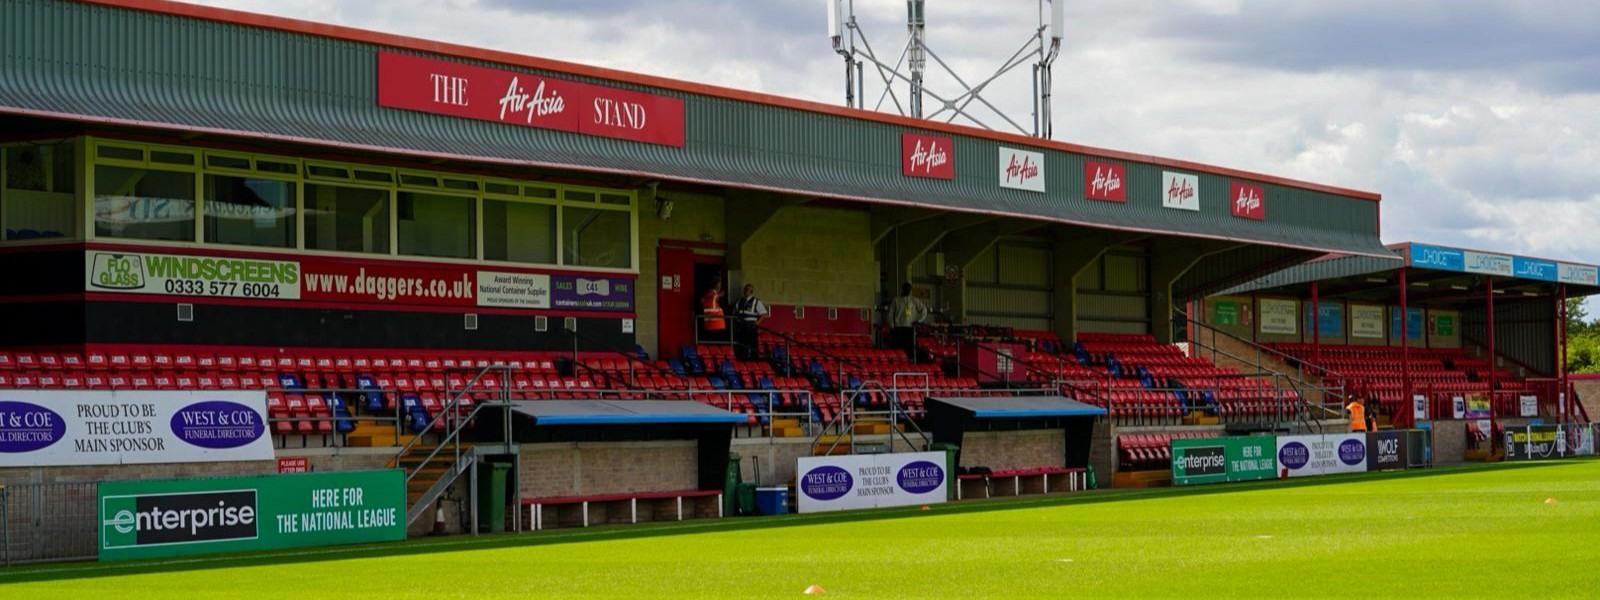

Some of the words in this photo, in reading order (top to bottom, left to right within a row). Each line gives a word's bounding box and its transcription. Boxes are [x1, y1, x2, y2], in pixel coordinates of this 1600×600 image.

[430, 73, 469, 106] THE
[499, 76, 565, 123] AirAsia
[593, 97, 646, 130] STAND
[910, 139, 947, 173] AirAsia
[1006, 153, 1038, 183] AirAsia
[1092, 167, 1121, 192] AirAsia
[108, 259, 130, 273] FLO
[145, 256, 298, 284] WINDSCREENS
[100, 271, 139, 286] GLASS
[305, 267, 473, 301] www.daggers.co.uk
[494, 274, 511, 284] Award
[512, 276, 533, 287] Winning
[165, 279, 205, 294] 0333
[209, 281, 238, 296] 577
[242, 283, 280, 297] 6004
[480, 285, 501, 293] National
[502, 286, 526, 295] Container
[77, 404, 120, 418] PROUD
[121, 404, 139, 418] TO
[142, 404, 157, 417] BE
[182, 410, 214, 426] WEST
[218, 410, 229, 425] &
[230, 410, 254, 425] COE
[9, 411, 22, 428] &
[24, 411, 53, 428] COE
[86, 421, 112, 435] THE
[112, 420, 153, 435] CLUB'S
[8, 431, 53, 442] DIRECTORS
[184, 429, 216, 439] FUNERAL
[217, 428, 256, 439] DIRECTORS
[74, 438, 109, 453] MAIN
[110, 437, 165, 451] SPONSOR
[1379, 438, 1398, 455] WOLF
[1177, 451, 1225, 472] enterprise
[807, 473, 825, 485] WEST
[826, 473, 834, 483] &
[834, 471, 848, 483] COE
[858, 467, 876, 476] PROUD
[902, 467, 919, 478] WEST
[920, 468, 926, 478] &
[926, 466, 938, 477] COE
[312, 488, 340, 508] HERE
[343, 487, 363, 506] FOR
[871, 486, 894, 496] SPONSOR
[113, 500, 255, 535] enterprise
[277, 514, 298, 533] THE
[302, 511, 354, 532] NATIONAL
[358, 508, 396, 529] LEAGUE
